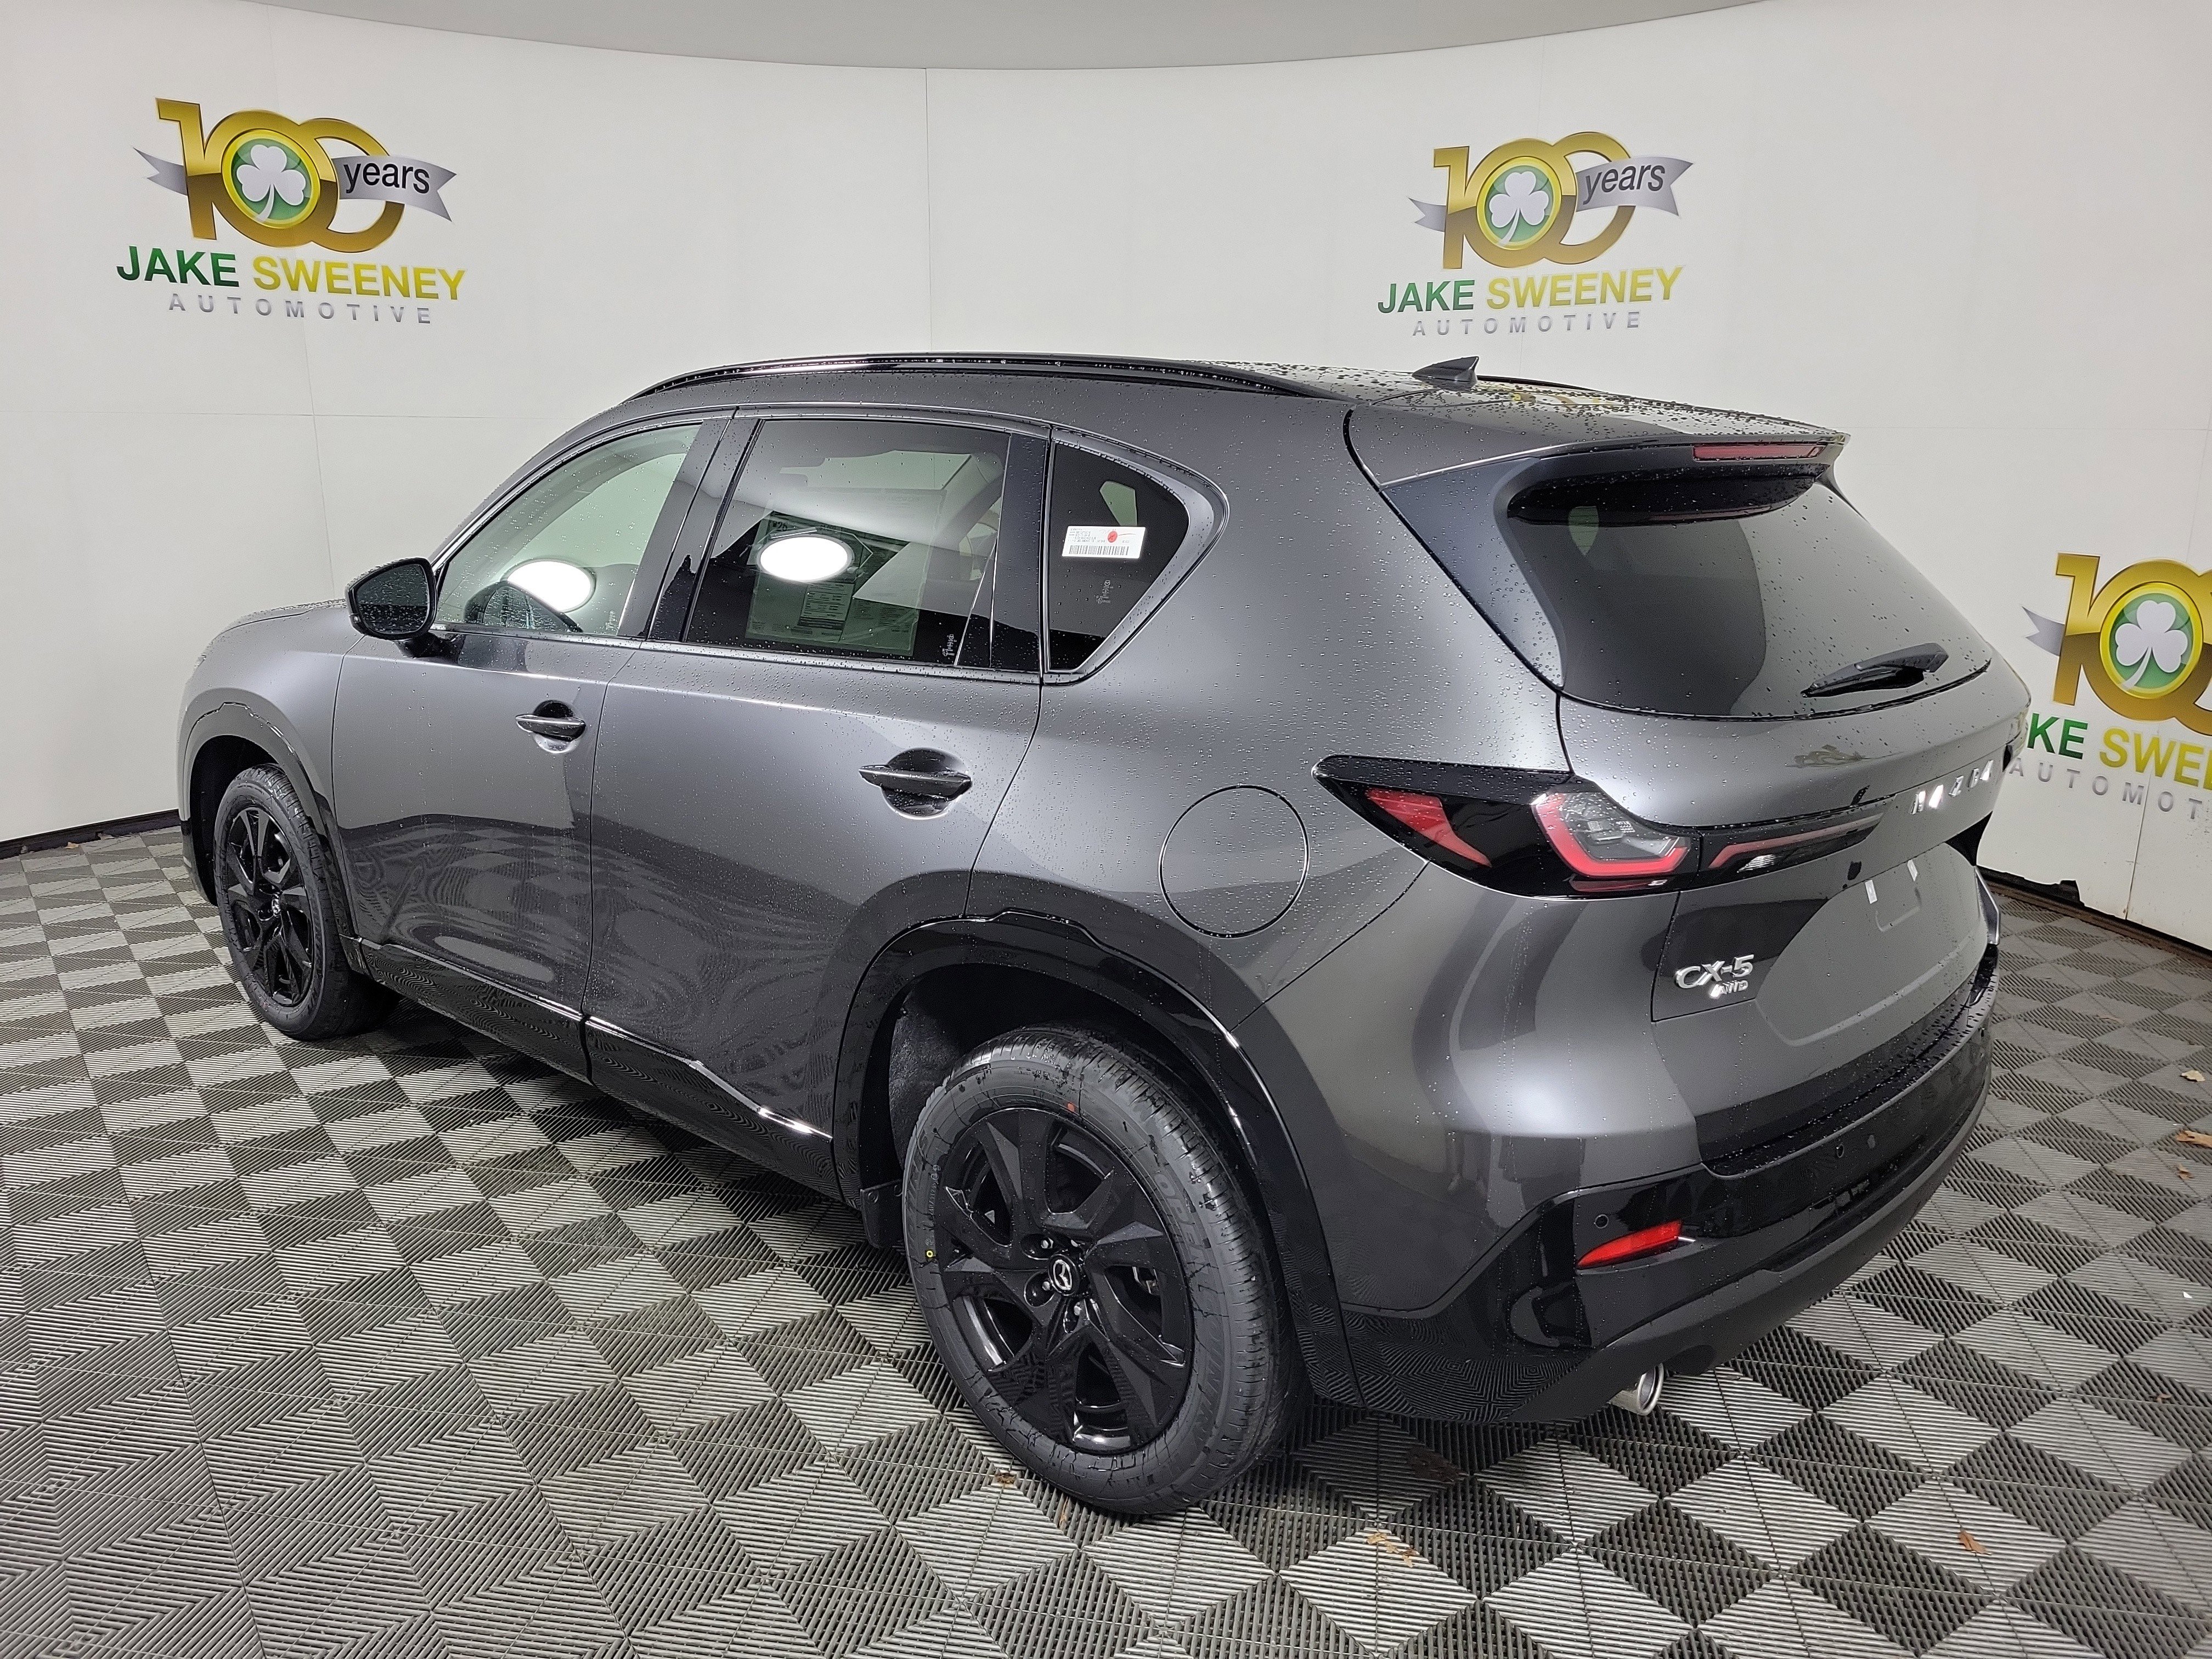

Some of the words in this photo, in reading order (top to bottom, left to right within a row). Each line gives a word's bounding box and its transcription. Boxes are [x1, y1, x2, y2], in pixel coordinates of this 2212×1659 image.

[155, 98, 405, 253] 100
[343, 161, 430, 195] years
[1433, 131, 1635, 270] 100
[1582, 163, 1666, 206] years
[116, 245, 240, 288] JAKE
[252, 256, 467, 301] SWEENEY
[1377, 279, 1476, 314] JAKE
[1486, 265, 1684, 311] SWEENEY
[168, 293, 431, 325] AUTOMOTIVE
[1412, 311, 1640, 337] AUTOMOTIVE
[2025, 712, 2089, 760] KE
[2099, 726, 2212, 791] SWE
[1674, 953, 1755, 989] CX-5
[1708, 979, 1749, 998] AWD
